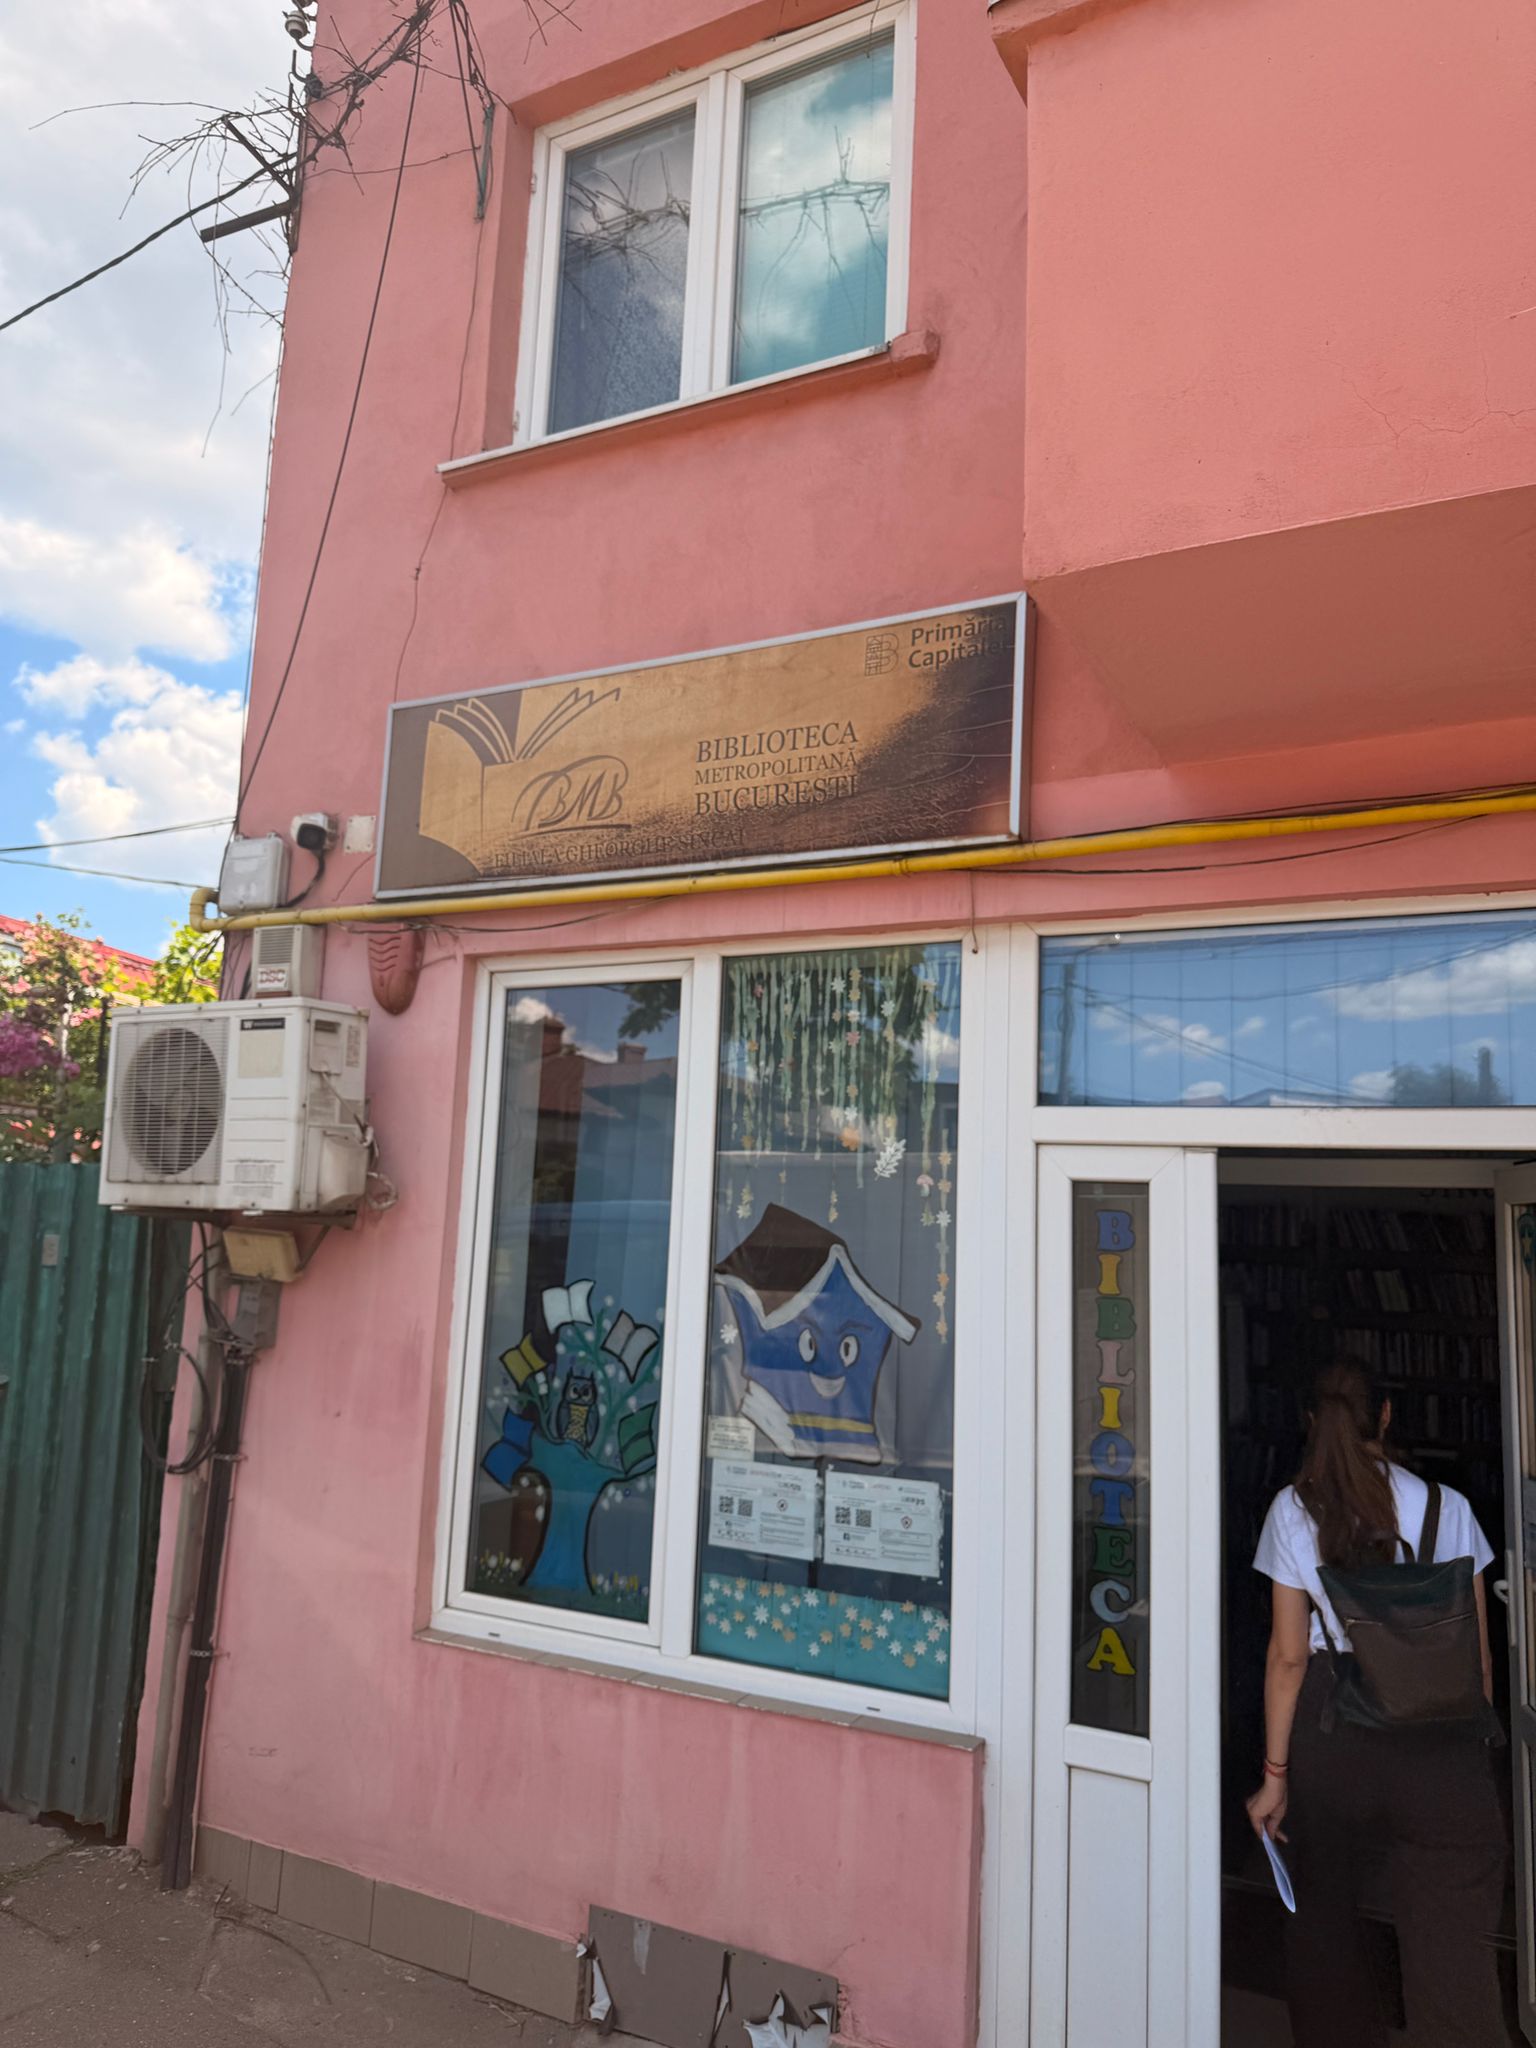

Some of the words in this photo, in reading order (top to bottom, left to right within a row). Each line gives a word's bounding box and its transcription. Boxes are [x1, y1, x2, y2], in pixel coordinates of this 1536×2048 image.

[696, 720, 858, 763] BIBLIOTECA
[695, 748, 857, 785] METROPOLITANĂ
[1086, 1210, 1135, 1675] BIBLIOTECA
